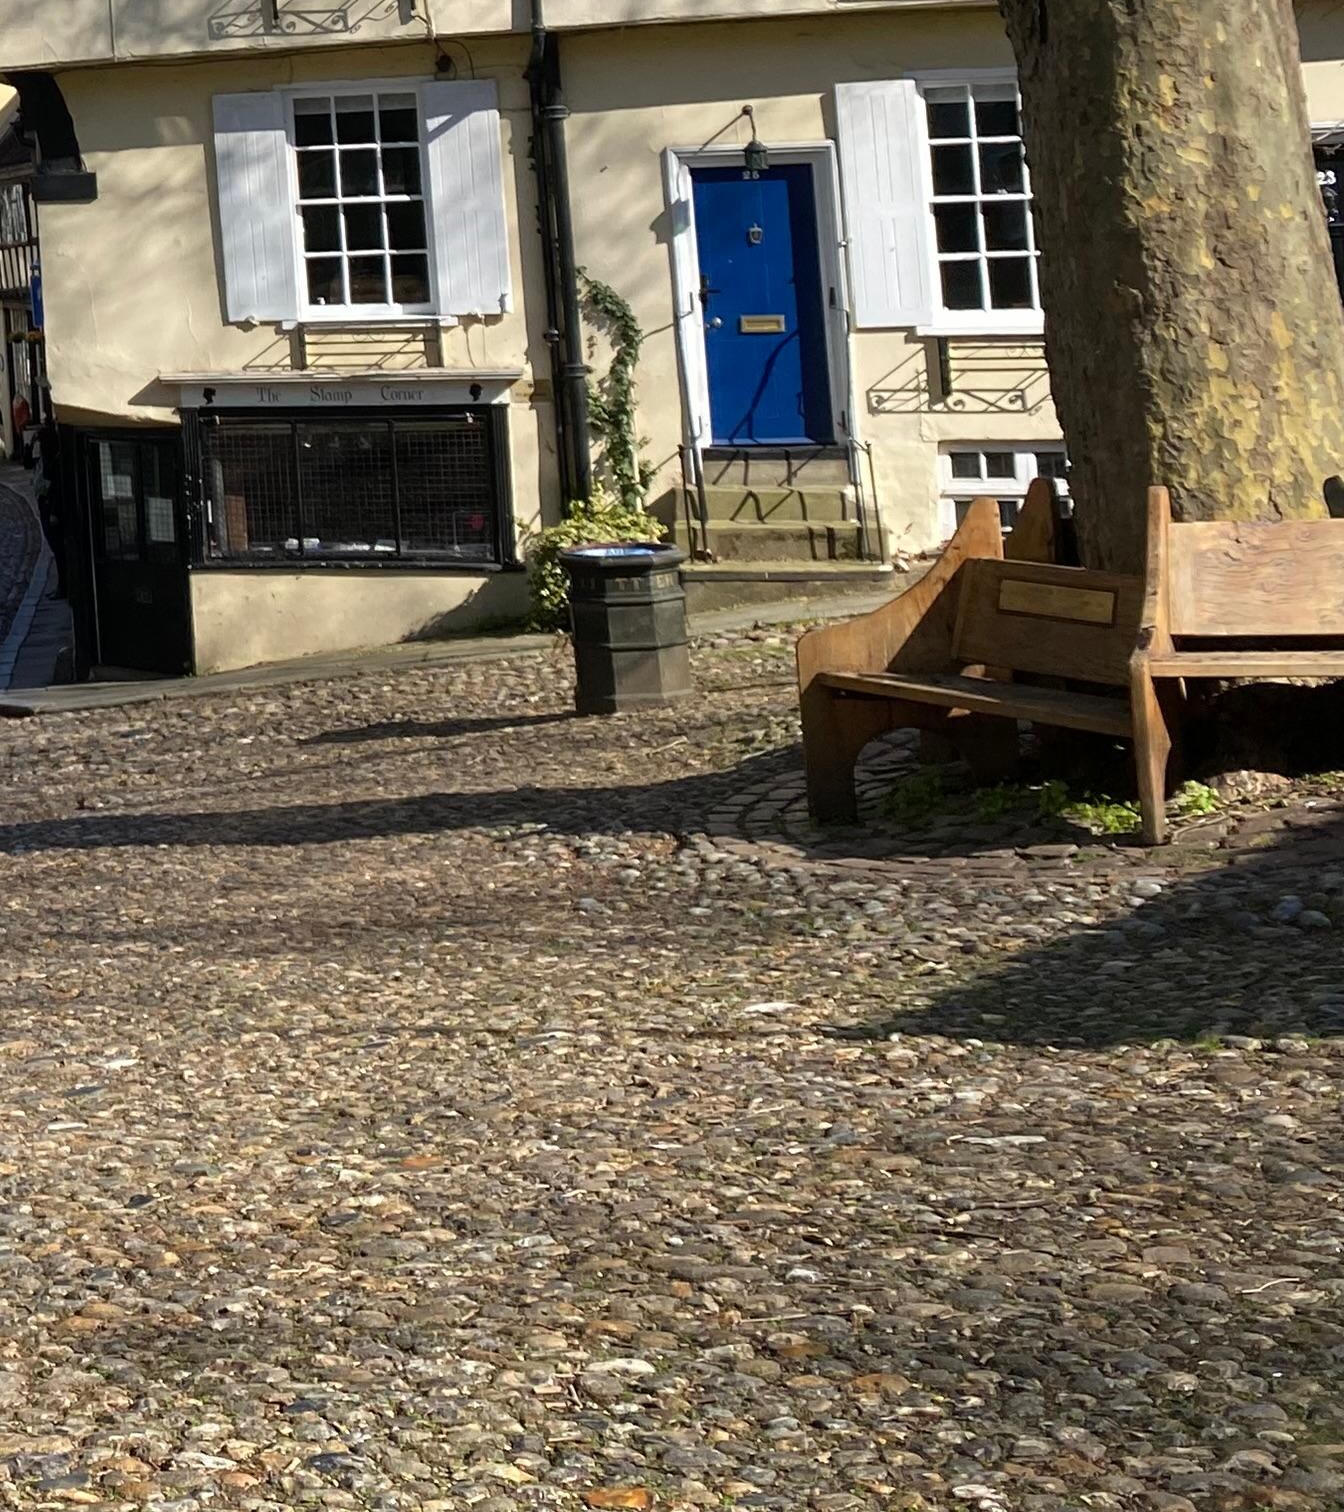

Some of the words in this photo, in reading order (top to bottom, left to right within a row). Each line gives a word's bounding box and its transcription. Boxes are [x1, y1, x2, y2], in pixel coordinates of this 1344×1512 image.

[1316, 170, 1336, 185] 23
[257, 387, 282, 402] The
[310, 385, 353, 404] Stamp
[380, 385, 424, 402] Corner
